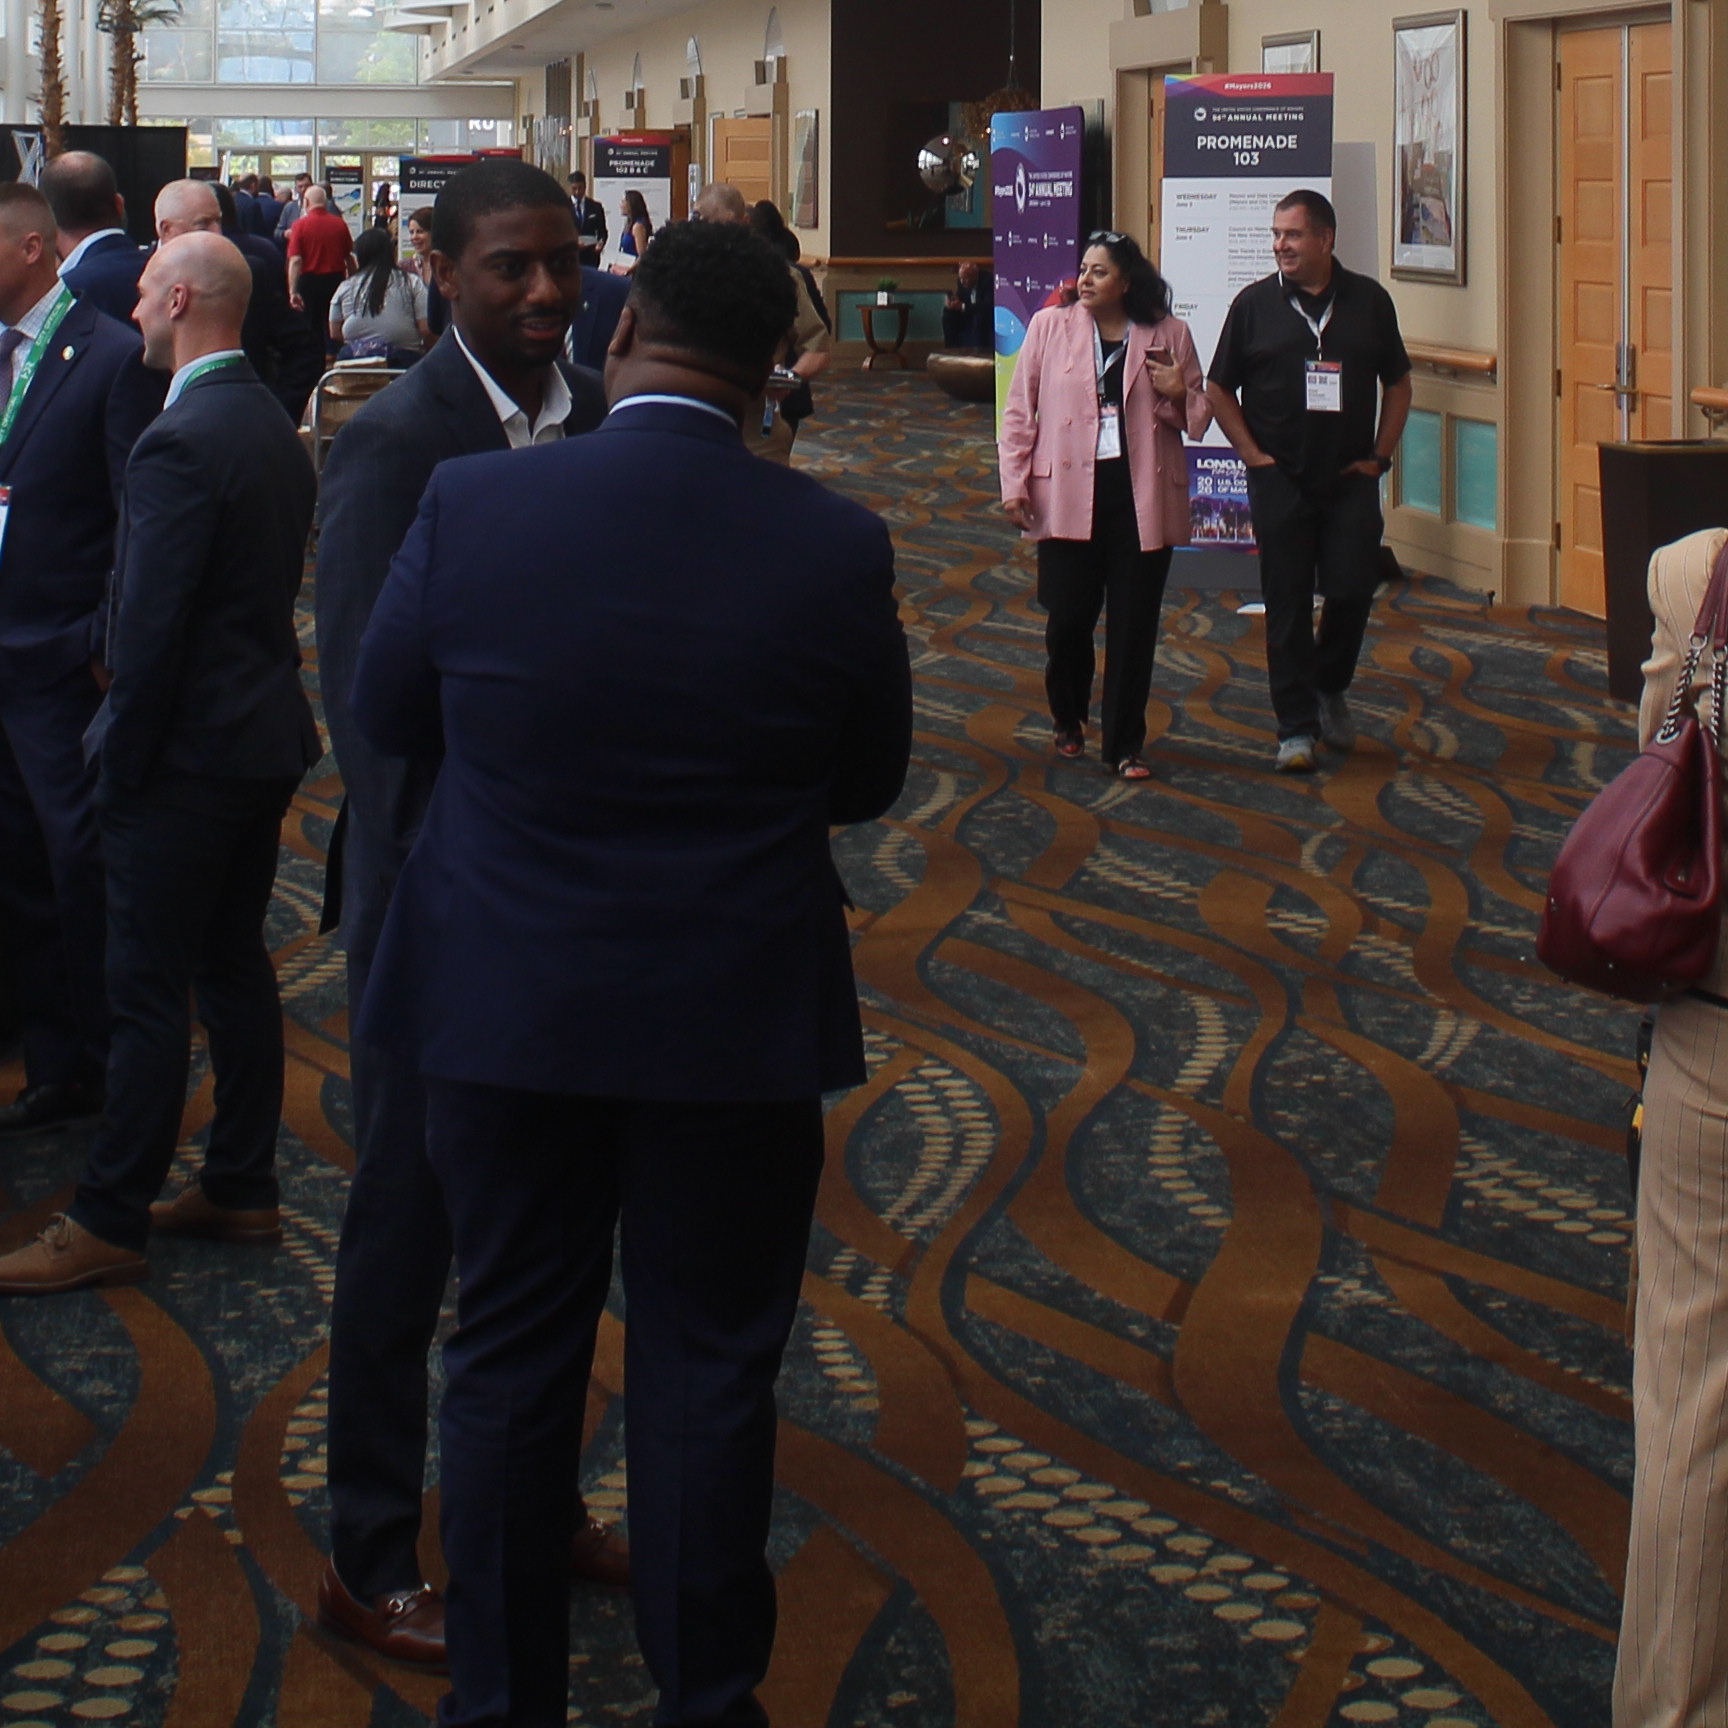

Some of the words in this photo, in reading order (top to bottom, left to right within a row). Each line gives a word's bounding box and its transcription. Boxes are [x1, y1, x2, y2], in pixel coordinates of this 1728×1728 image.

[1227, 113, 1262, 122] ANNUAL
[1265, 112, 1304, 121] MEETING
[1197, 134, 1298, 150] PROMENADE
[1233, 152, 1260, 166] 103
